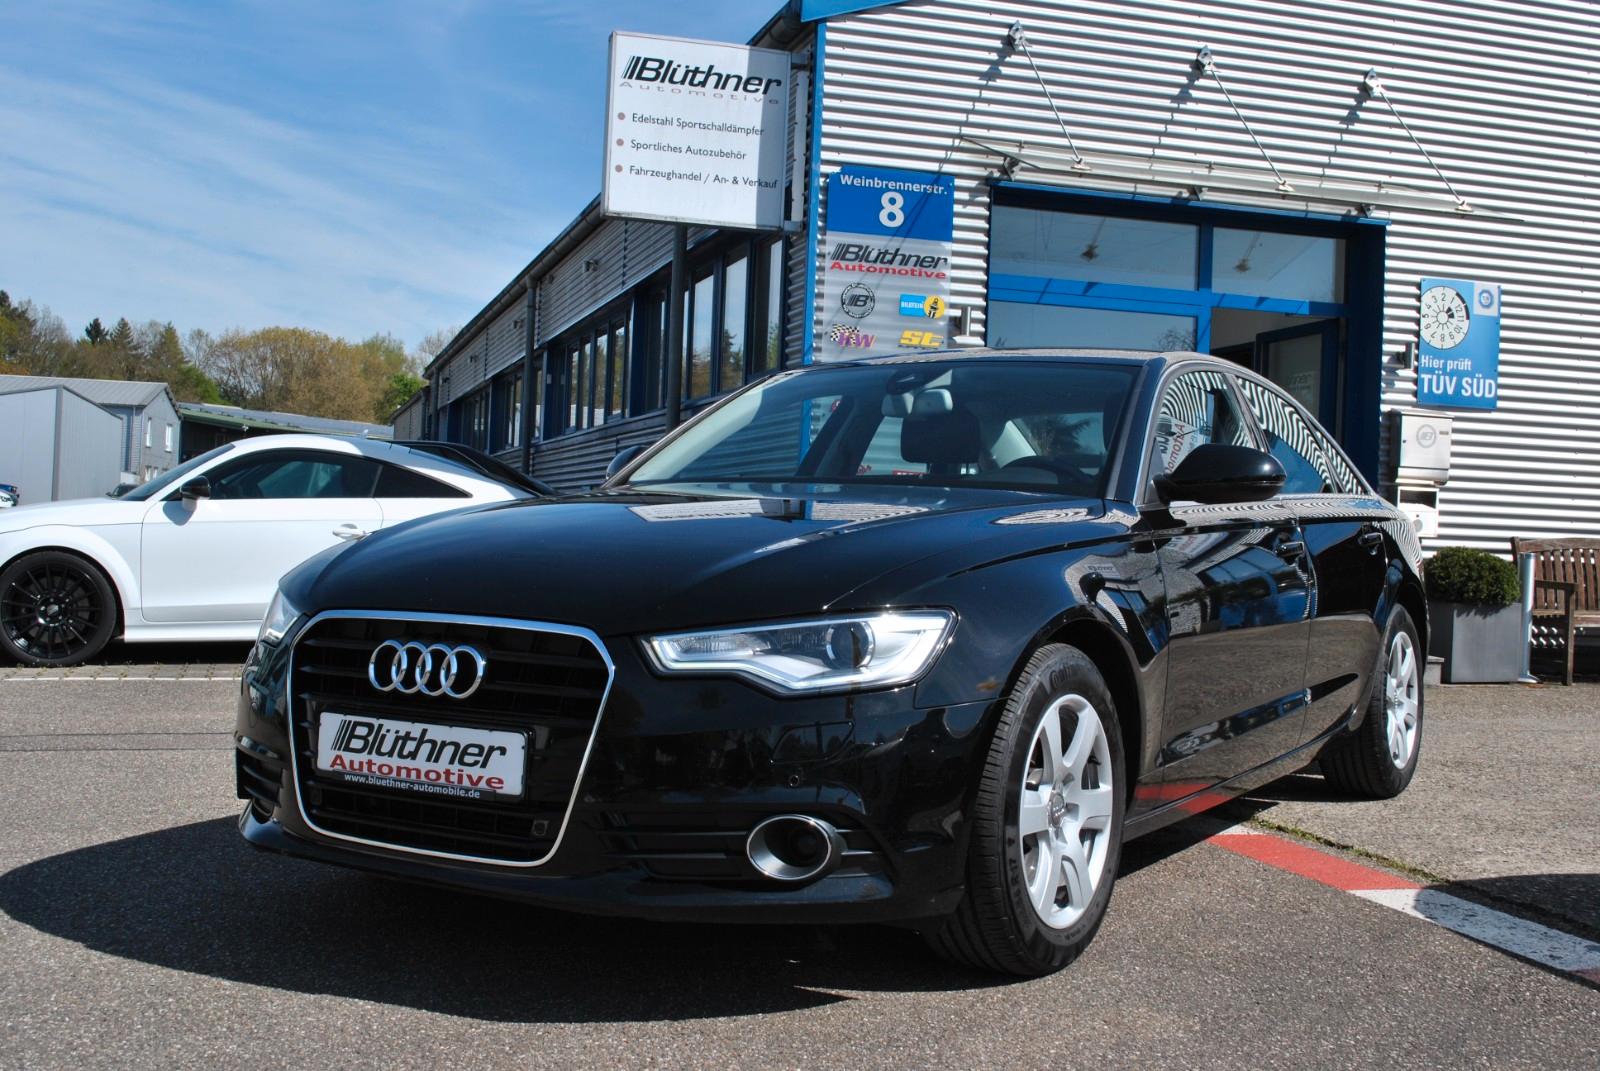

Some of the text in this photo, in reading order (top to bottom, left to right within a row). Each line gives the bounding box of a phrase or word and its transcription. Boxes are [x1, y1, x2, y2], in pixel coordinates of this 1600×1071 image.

[633, 56, 782, 95] Blüthner
[619, 81, 779, 104] Automotive
[632, 113, 765, 136] Edelstahl Sportschalldämpfer
[631, 139, 747, 160] Sportliches Autozubehör
[629, 165, 702, 182] Fahrzeughandel
[713, 174, 730, 184] An-
[731, 176, 739, 185] &
[742, 177, 778, 189] Verkauf
[840, 174, 948, 195] Weinbrennerstr.
[879, 191, 905, 228] 8
[830, 262, 947, 280] Automotive
[1421, 355, 1472, 372] Hier prüft
[1420, 370, 1496, 398] TÜV SÜD
[339, 719, 507, 769] Blüthner
[329, 754, 504, 790] Automotive
[344, 773, 480, 799] www.bluethner-automobile.de
